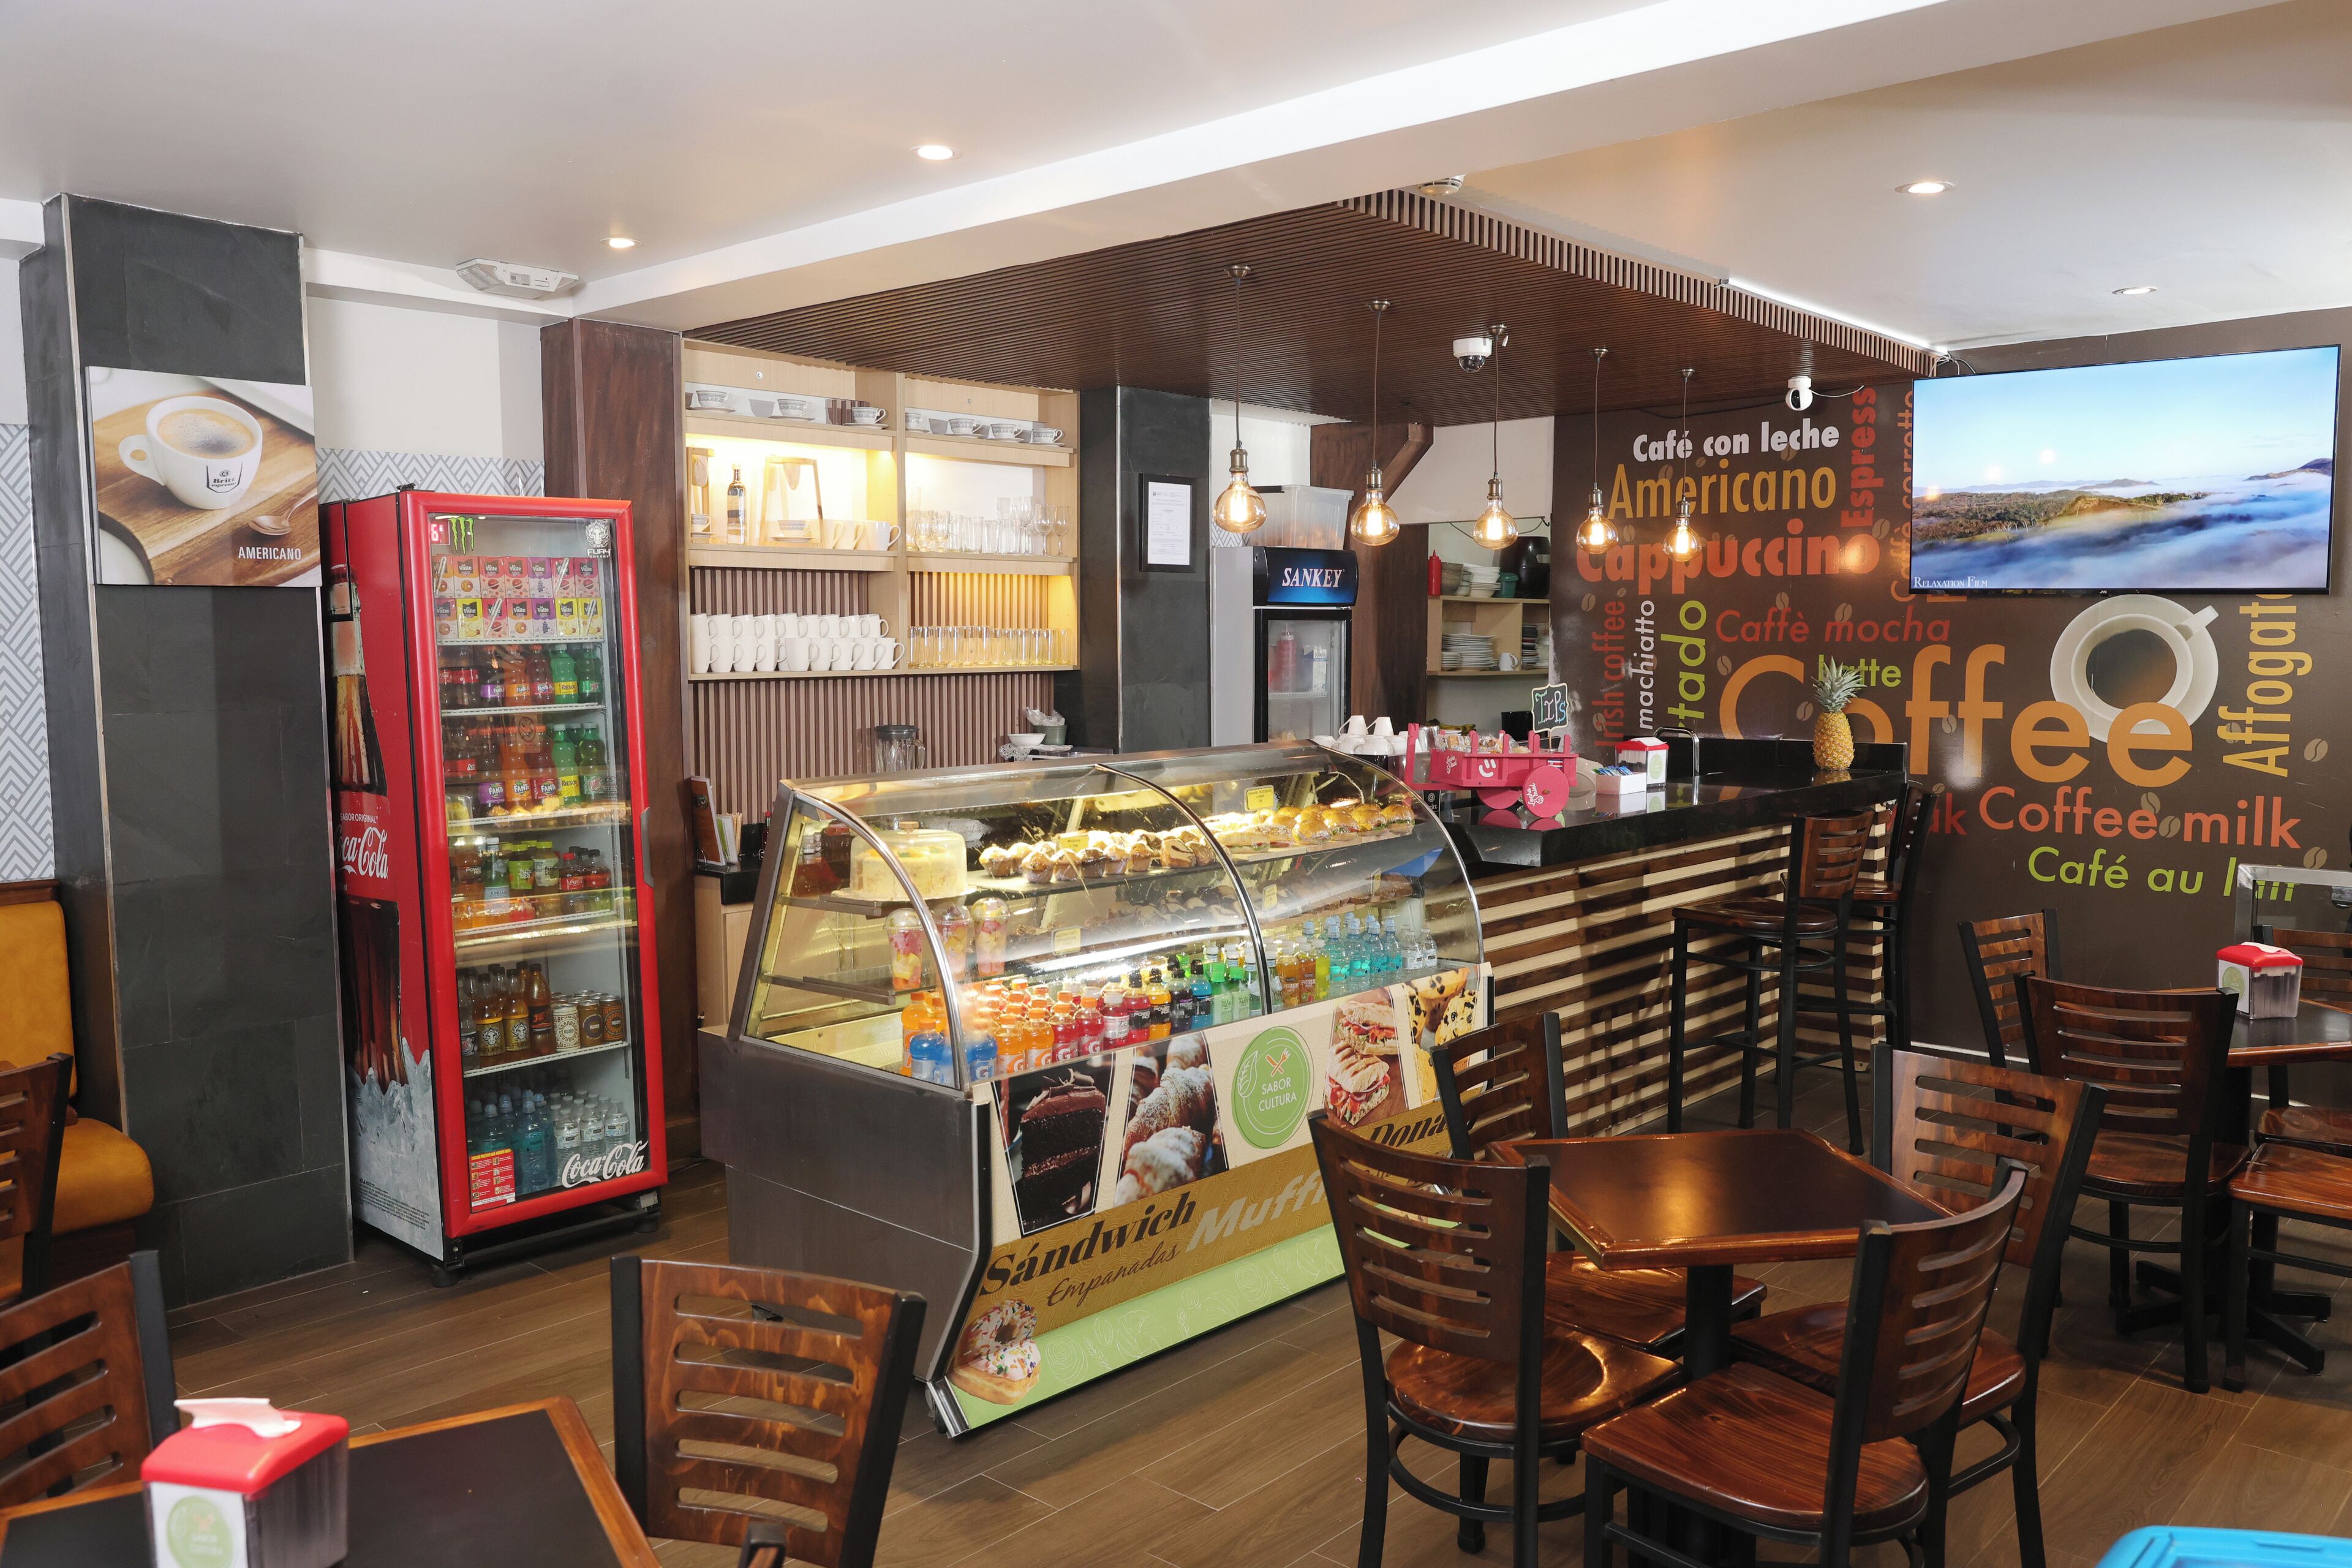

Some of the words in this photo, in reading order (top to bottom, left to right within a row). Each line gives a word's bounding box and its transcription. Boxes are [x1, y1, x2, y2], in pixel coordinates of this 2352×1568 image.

[1633, 429, 1693, 462] Café
[1703, 433, 1750, 457] con
[1761, 418, 1839, 453] leche
[1607, 458, 1836, 520] Americano
[238, 546, 301, 560] AMERICANO
[587, 548, 611, 557] FURY
[1282, 567, 1343, 587] SANKEY
[1576, 518, 1880, 595] Cappuccino
[1591, 600, 1625, 680] coffee
[1716, 606, 1809, 643] Caffè
[1824, 605, 1950, 643] mocha
[1632, 600, 1655, 729] machiatto
[2217, 594, 2313, 777] Affogat
[1591, 692, 1625, 746] Irish
[1980, 786, 2157, 840] Coffee
[2184, 796, 2302, 849] milk
[2028, 846, 2128, 889] Café
[2147, 869, 2203, 894] au
[1259, 1091, 1297, 1112] CULTURA
[1262, 1077, 1291, 1095] SABOR
[562, 1140, 649, 1188] Coca-Cola
[979, 1191, 1197, 1297] Sándwich
[1047, 1242, 1183, 1308] Empanadas
